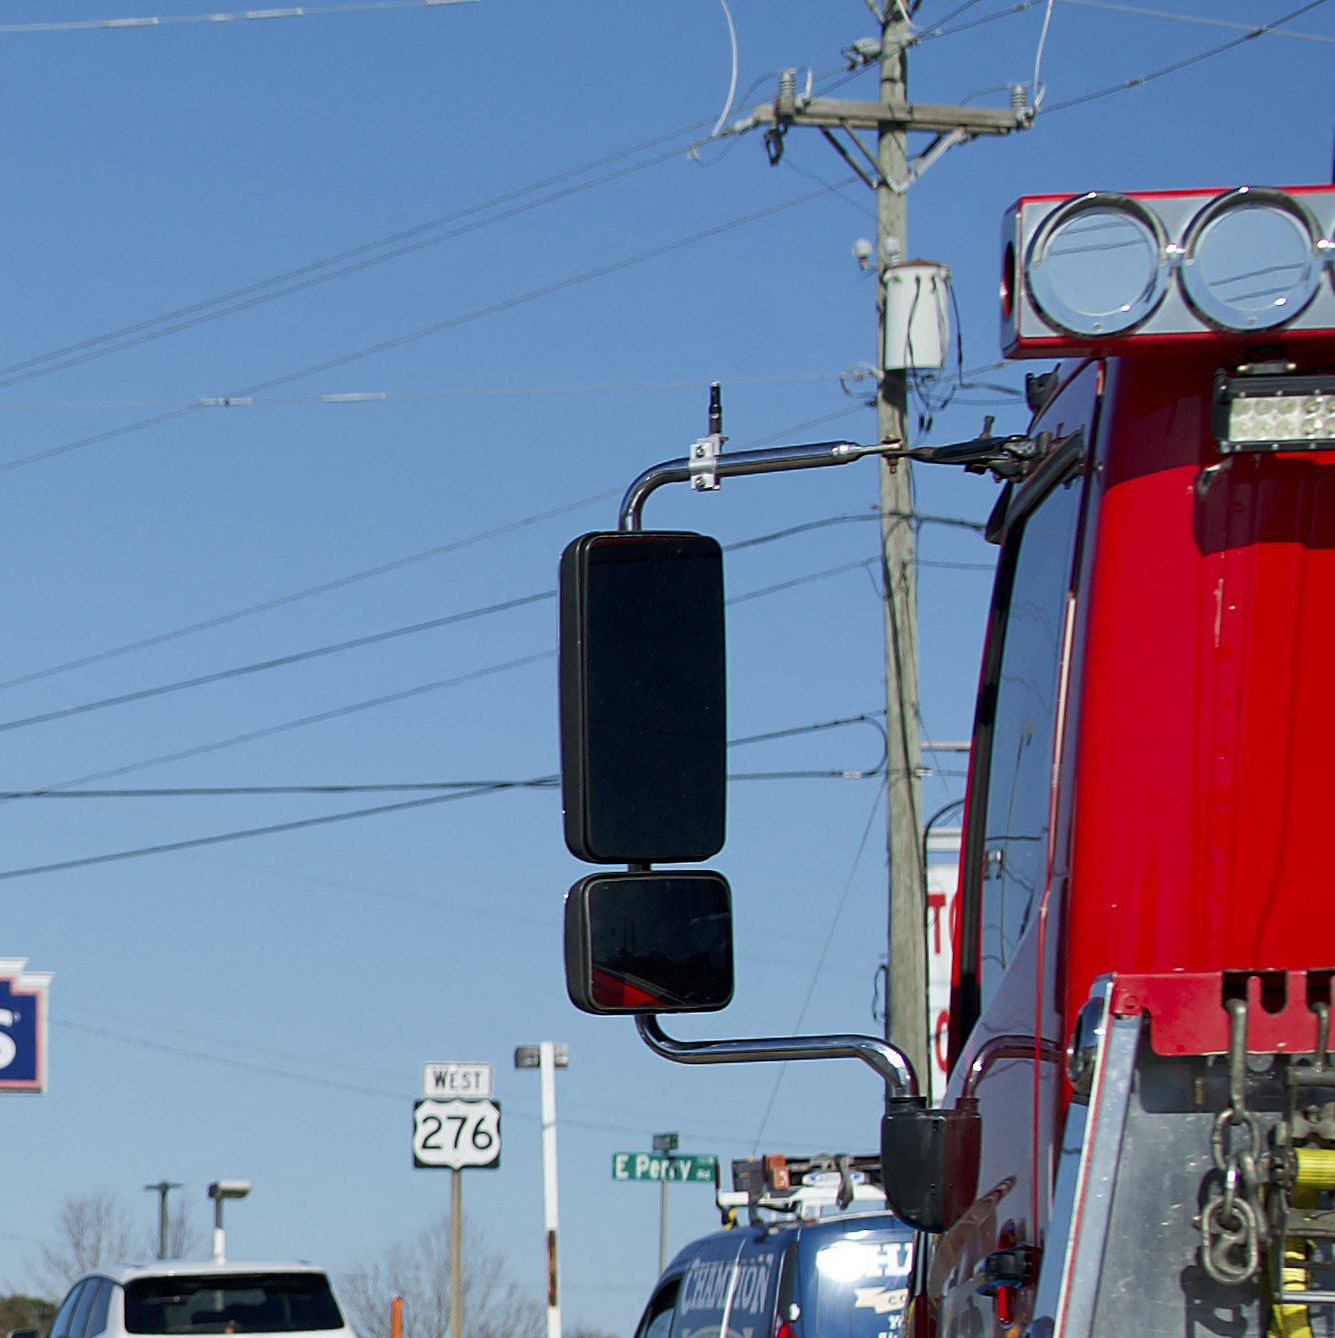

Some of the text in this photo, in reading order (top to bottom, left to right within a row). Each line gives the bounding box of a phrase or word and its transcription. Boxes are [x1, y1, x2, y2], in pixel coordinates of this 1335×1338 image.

[433, 1070, 483, 1089] WEST
[421, 1116, 493, 1150] 276
[615, 1154, 629, 1178] E
